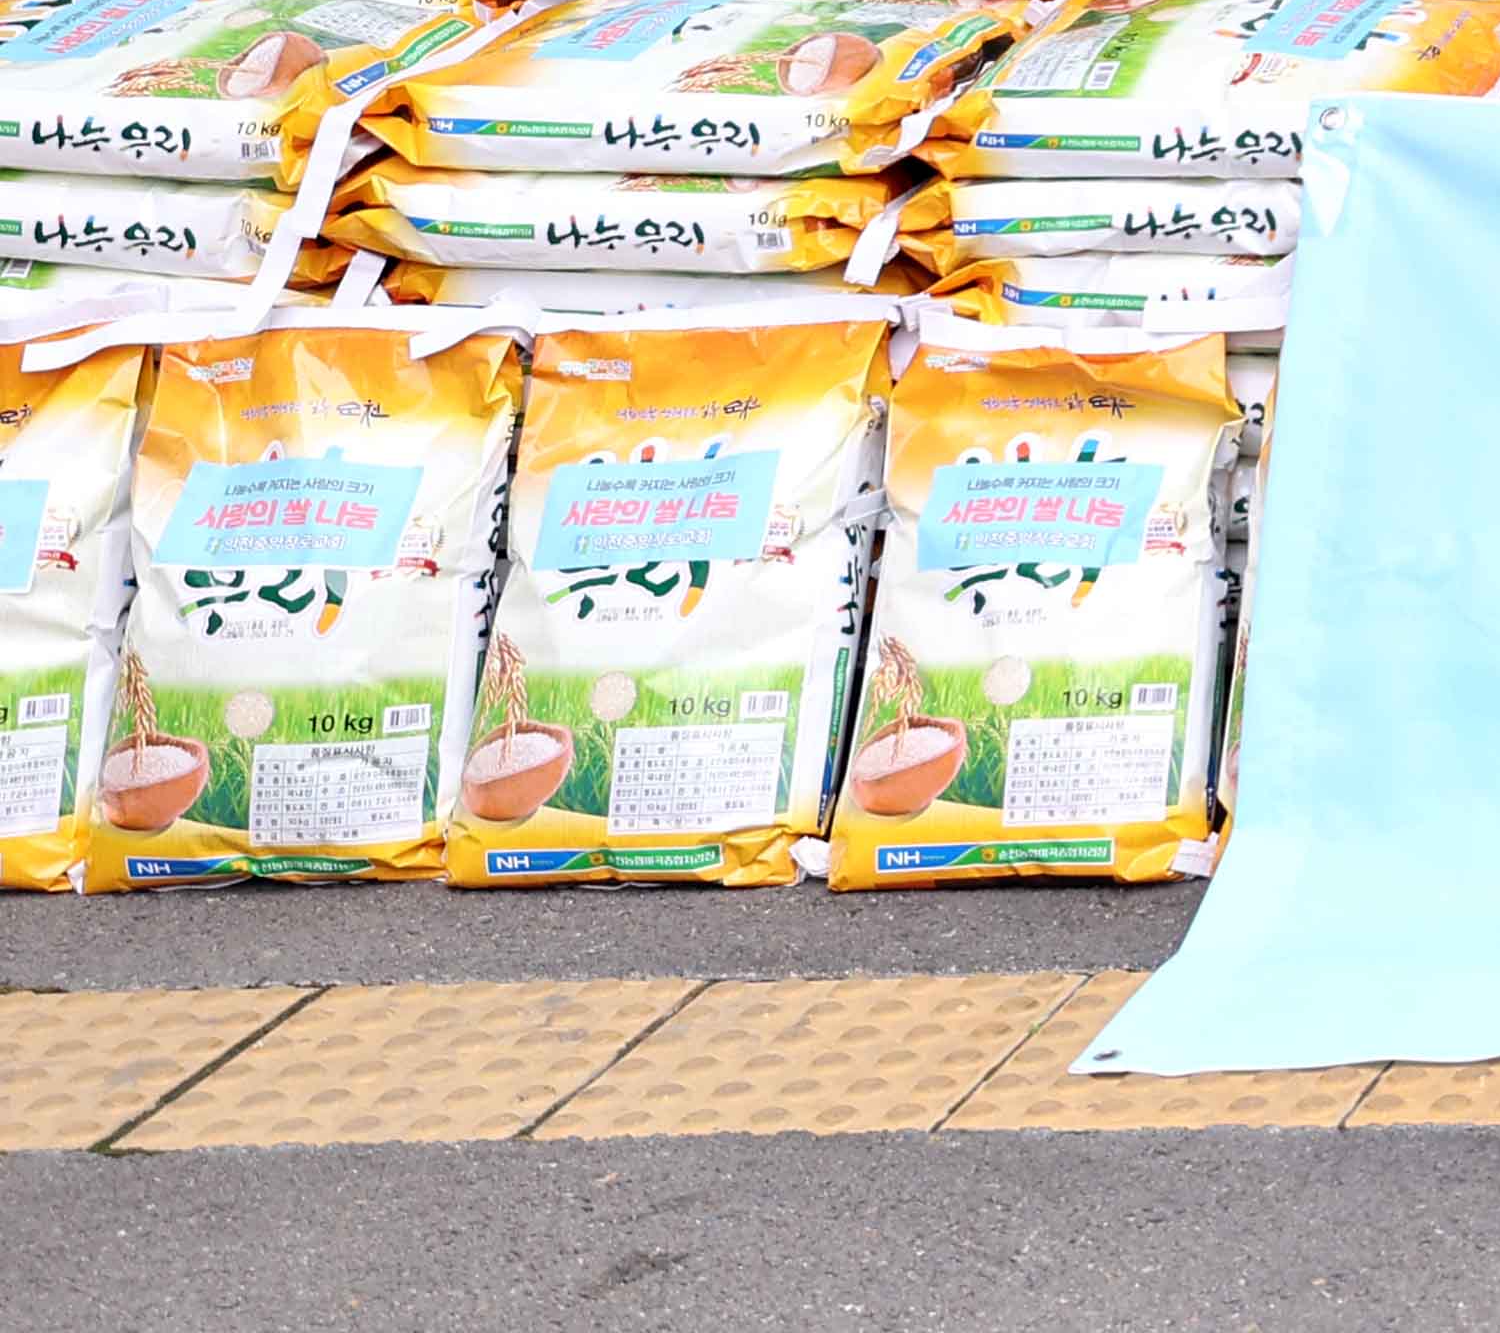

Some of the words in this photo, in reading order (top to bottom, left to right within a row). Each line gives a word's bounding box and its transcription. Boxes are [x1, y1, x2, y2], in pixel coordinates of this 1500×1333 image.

[195, 498, 278, 530] 사랑의
[283, 498, 312, 526] 쌀
[316, 500, 378, 531] 나눔
[561, 498, 650, 526] 사랑의
[653, 497, 683, 525] 쌀
[685, 492, 739, 520] 나눔
[943, 496, 1027, 525] 사랑의
[1033, 497, 1063, 524] 쌀
[1066, 496, 1125, 528] 나눔
[667, 697, 696, 717] 10
[701, 696, 731, 720] kg
[1062, 689, 1090, 708] 10
[1094, 686, 1123, 712] kg
[497, 854, 530, 870] NH
[887, 852, 920, 867] NH
